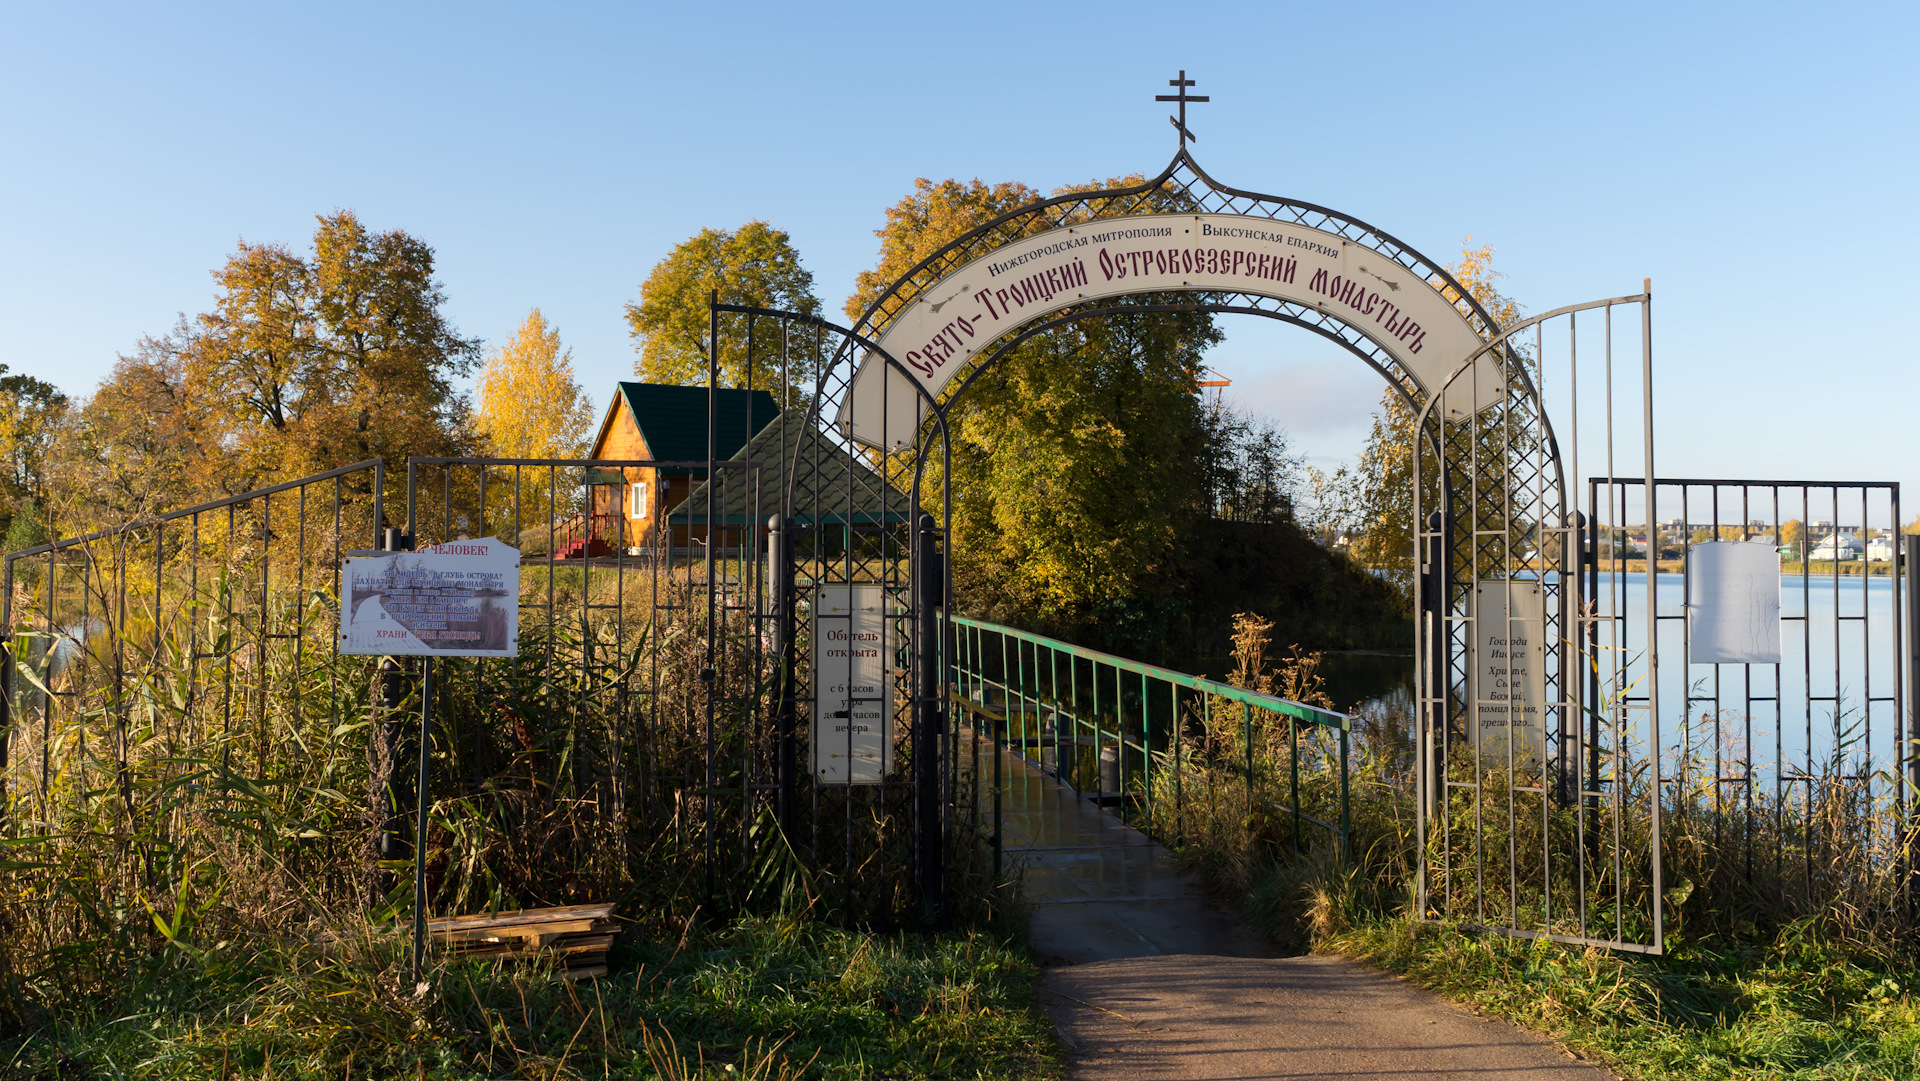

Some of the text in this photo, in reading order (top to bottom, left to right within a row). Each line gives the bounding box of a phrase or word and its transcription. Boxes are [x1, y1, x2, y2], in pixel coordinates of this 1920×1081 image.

[431, 545, 488, 556] ЧЕЛОВЕК!
[440, 571, 465, 579] ГЛУБЬ
[466, 572, 503, 580] ОСТРОВА?
[355, 577, 391, 585] ЗАХВАТИ
[376, 630, 407, 639] ХРАНИ
[1488, 666, 1528, 677] Хрите,
[838, 684, 844, 693] 6
